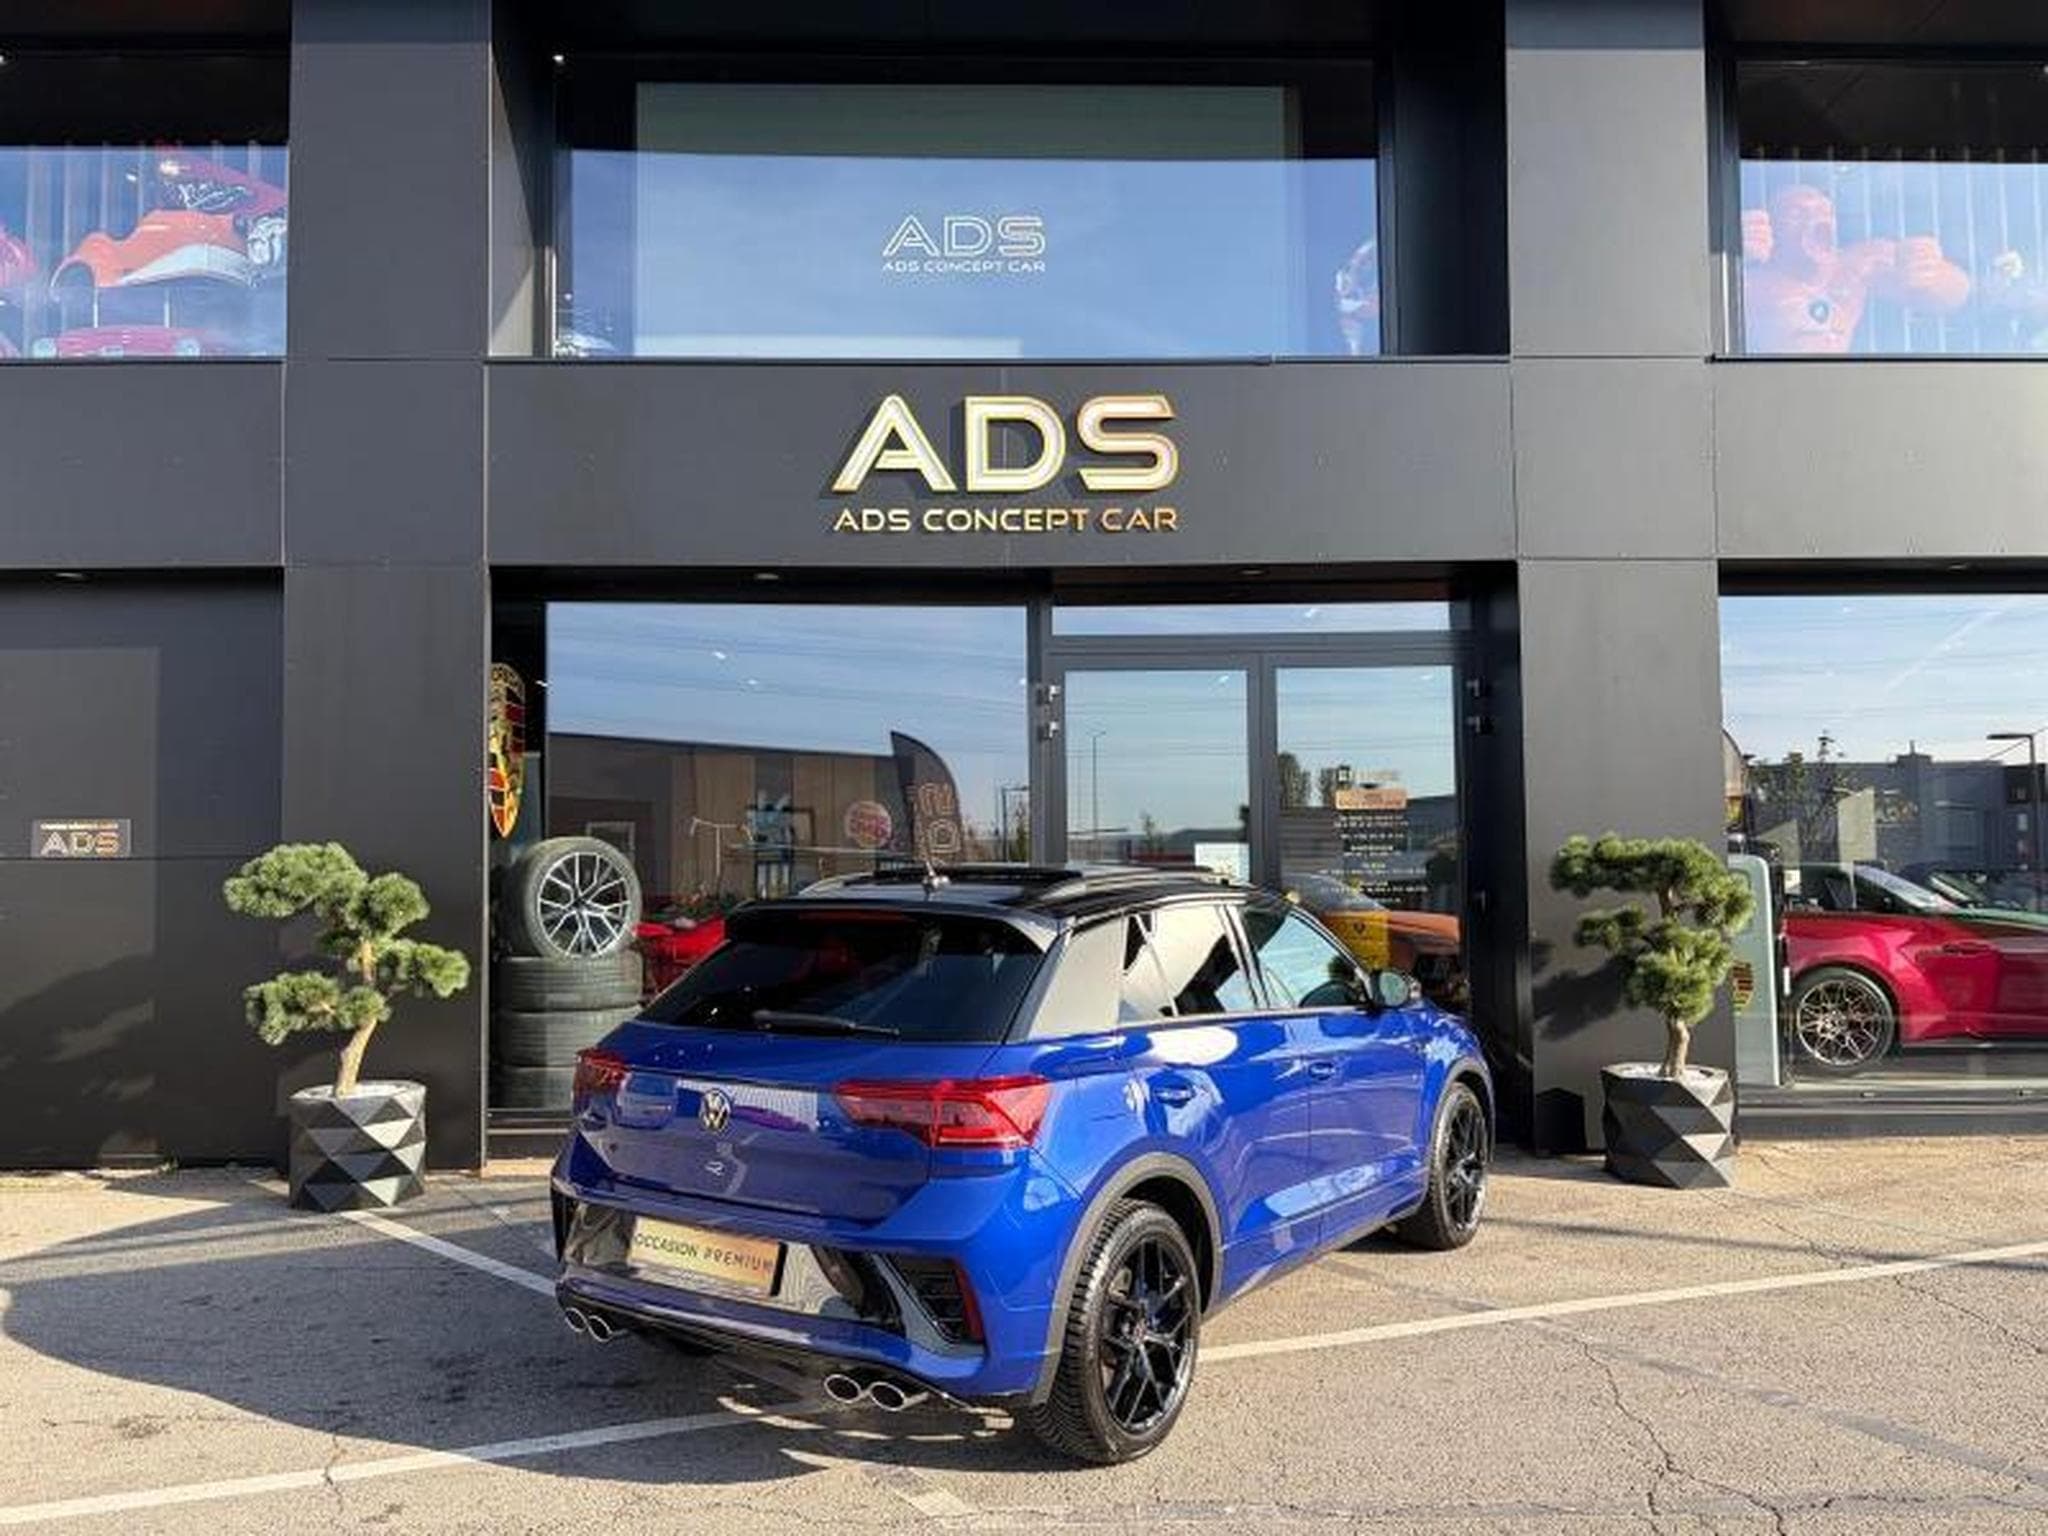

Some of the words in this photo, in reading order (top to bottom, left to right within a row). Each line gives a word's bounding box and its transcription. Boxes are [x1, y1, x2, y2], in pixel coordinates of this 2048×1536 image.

[882, 214, 1046, 257] ADS
[882, 260, 919, 273] ADS
[924, 260, 1003, 273] CONCEPT
[1008, 260, 1046, 273] CAR
[831, 394, 1179, 493] ADS
[833, 508, 911, 533] ADS
[923, 508, 1089, 533] CONCEPT
[1101, 507, 1178, 532] CAR
[41, 831, 119, 857] ADS
[635, 1232, 698, 1258] OCCASION
[703, 1247, 773, 1273] PREMIUM
